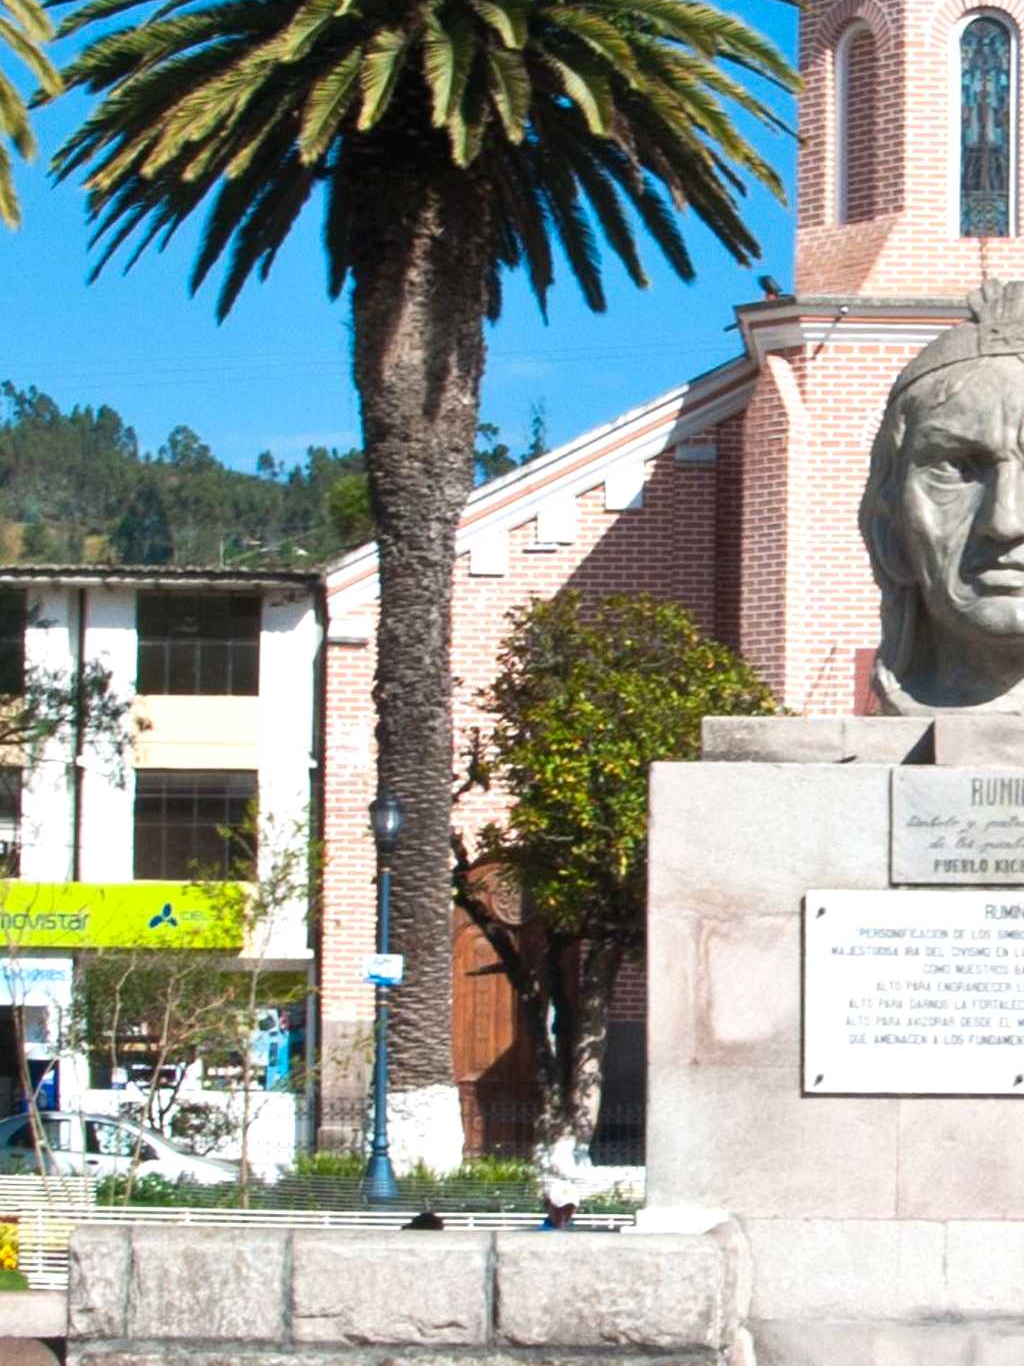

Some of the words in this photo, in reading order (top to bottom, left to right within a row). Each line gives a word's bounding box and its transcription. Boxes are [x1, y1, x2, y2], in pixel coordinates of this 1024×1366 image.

[933, 859, 988, 873] PUEBLO
[953, 929, 965, 940] DE
[971, 929, 991, 940] LOS
[925, 946, 945, 957] DEL
[996, 946, 1009, 957] EN
[923, 964, 951, 974] COMO
[956, 964, 1009, 975] NUESTROS
[906, 980, 931, 991] PARA
[954, 999, 967, 1010] LA
[875, 1016, 901, 1027] PARA
[960, 1016, 993, 1028] DESDE
[999, 1017, 1012, 1028] EL
[848, 1033, 867, 1044] QUE
[943, 1034, 965, 1045] LOS
